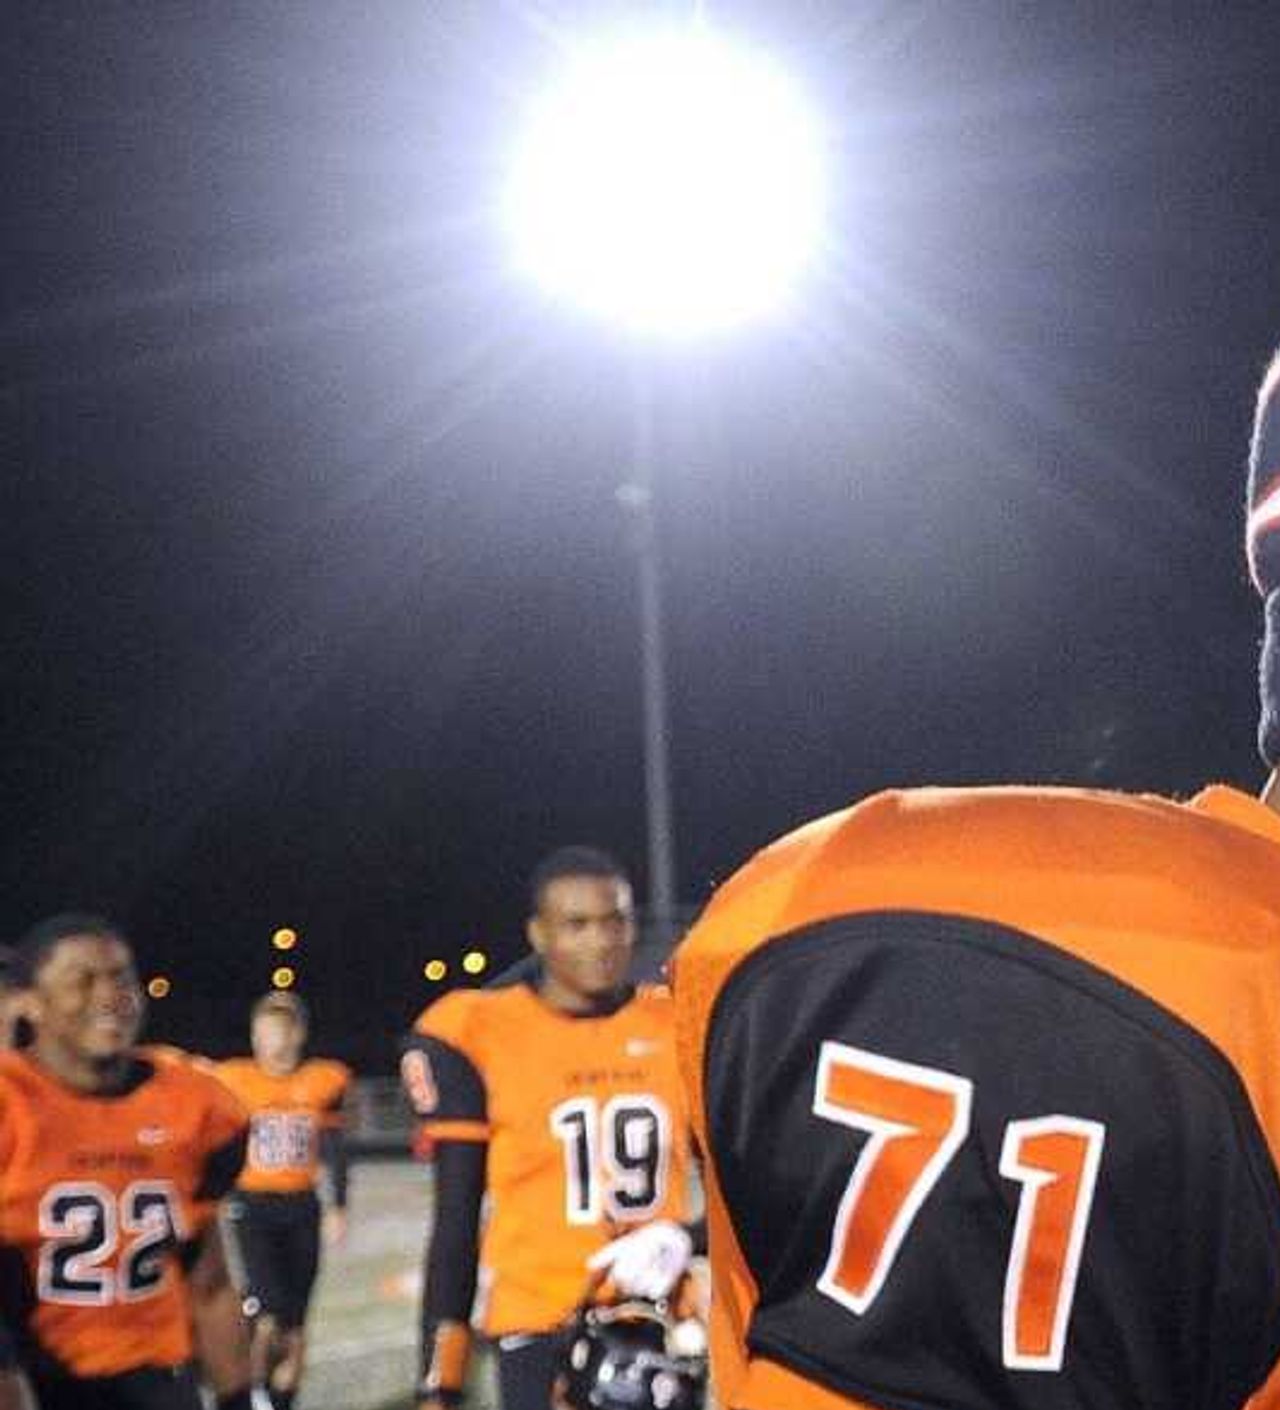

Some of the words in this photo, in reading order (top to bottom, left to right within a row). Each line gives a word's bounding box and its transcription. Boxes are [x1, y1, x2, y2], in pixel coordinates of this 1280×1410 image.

[549, 1094, 672, 1225] 19
[813, 1041, 1106, 1372] 71
[38, 1180, 192, 1307] 22
